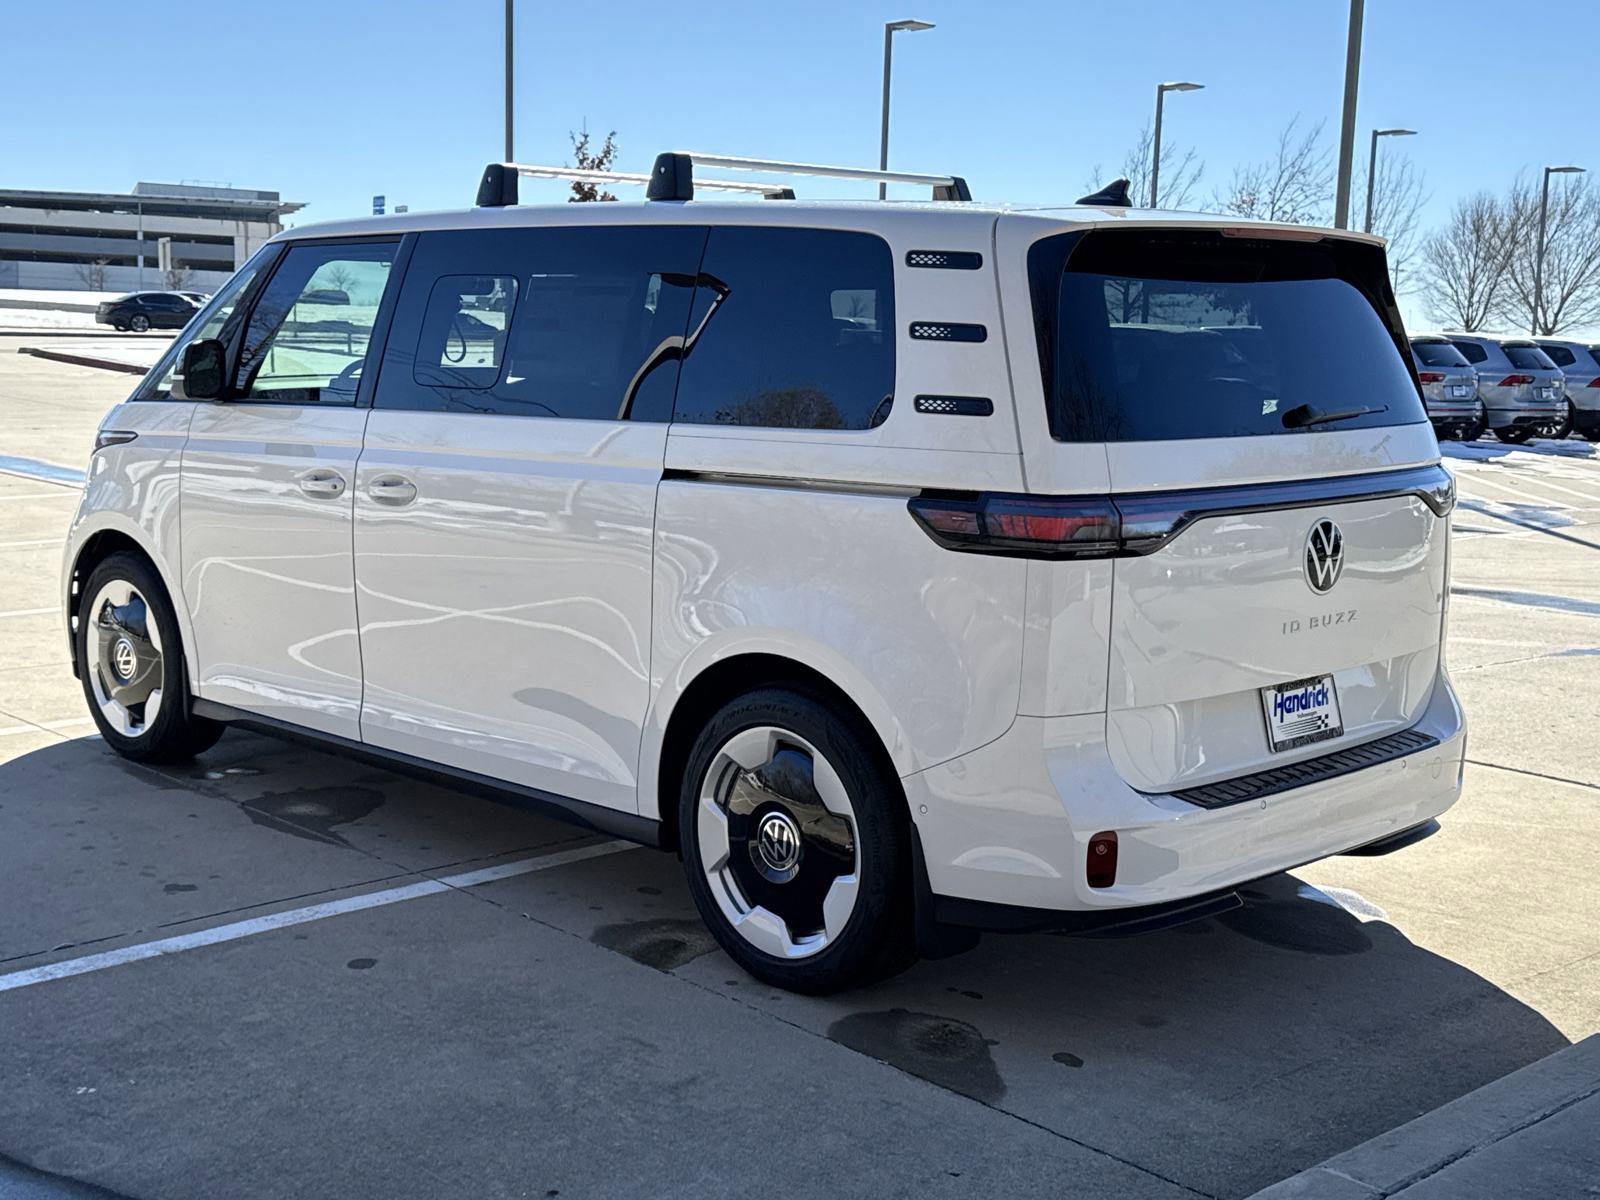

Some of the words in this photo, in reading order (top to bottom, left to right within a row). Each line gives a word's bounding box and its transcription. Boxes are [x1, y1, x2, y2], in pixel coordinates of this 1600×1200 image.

[1305, 519, 1343, 591] VW
[1309, 609, 1357, 629] BUZZ
[1273, 683, 1329, 723] Hendrick
[761, 817, 795, 865] VW
